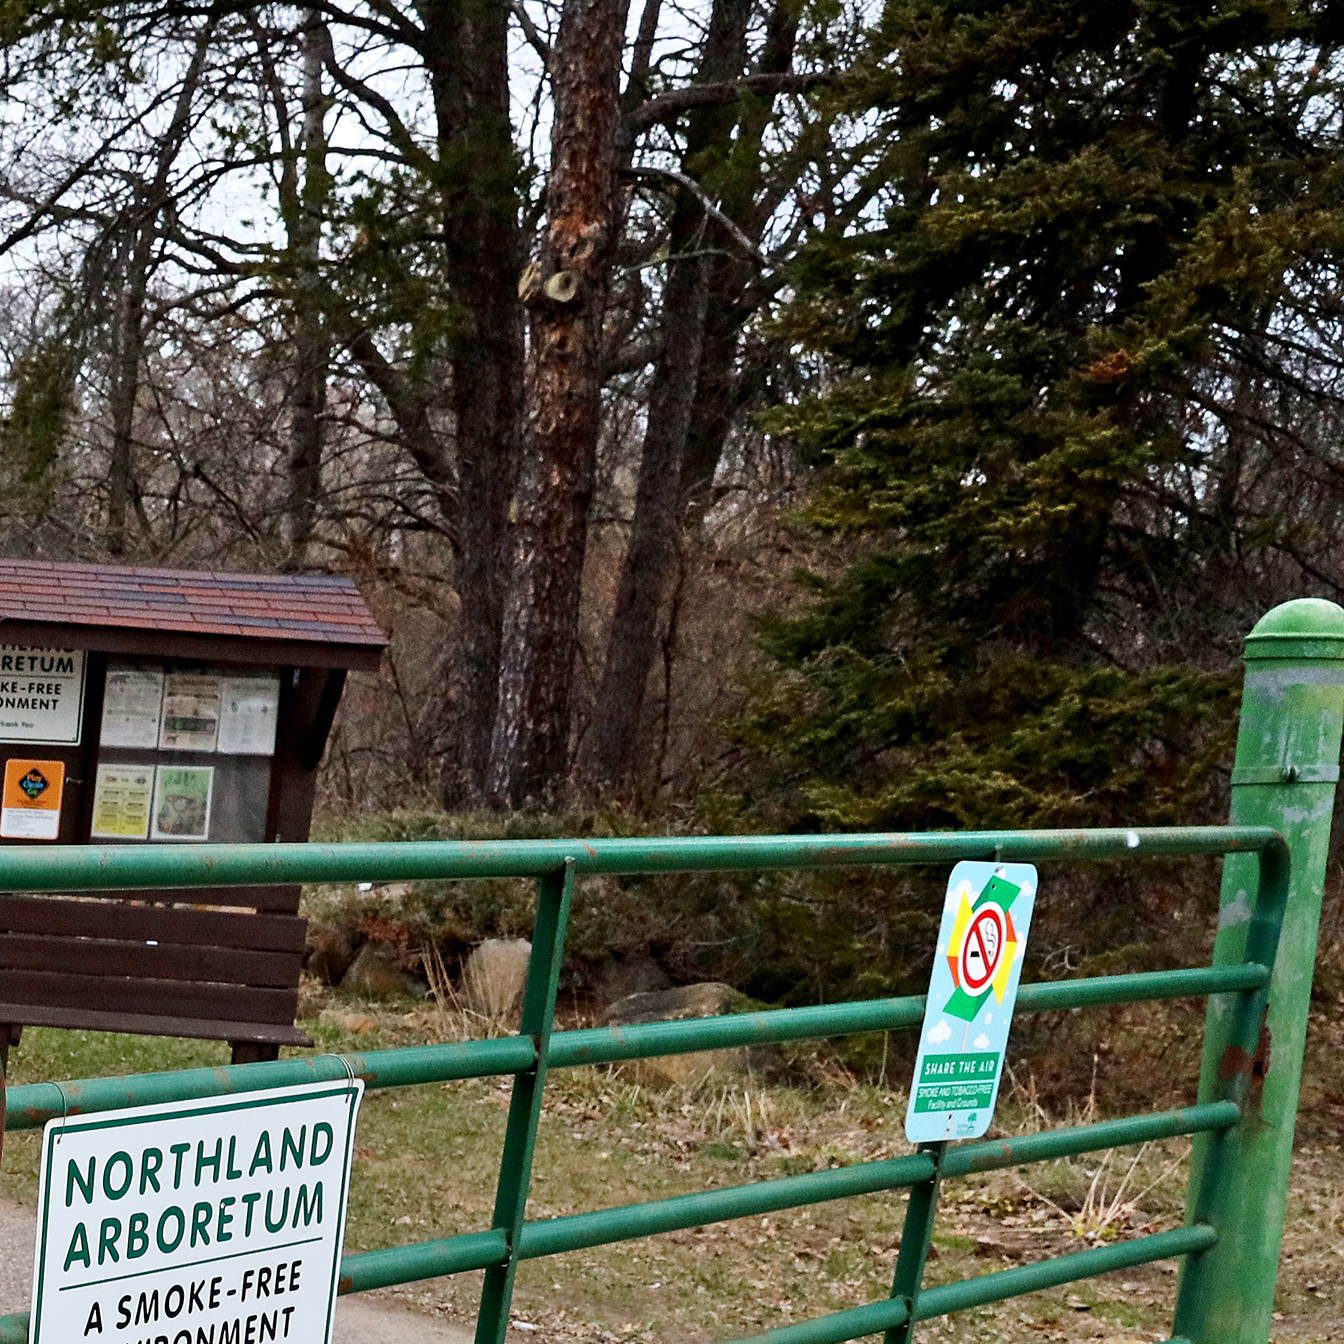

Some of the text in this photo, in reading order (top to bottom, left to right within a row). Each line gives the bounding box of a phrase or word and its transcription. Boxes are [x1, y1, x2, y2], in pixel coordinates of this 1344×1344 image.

[21, 721, 35, 729] You
[924, 1060, 995, 1075] SHARE THE AIR
[65, 1122, 334, 1207] NORTHLAND
[63, 1181, 324, 1272] ARBORETUM
[83, 1260, 303, 1337] A SMOKE-FREE
